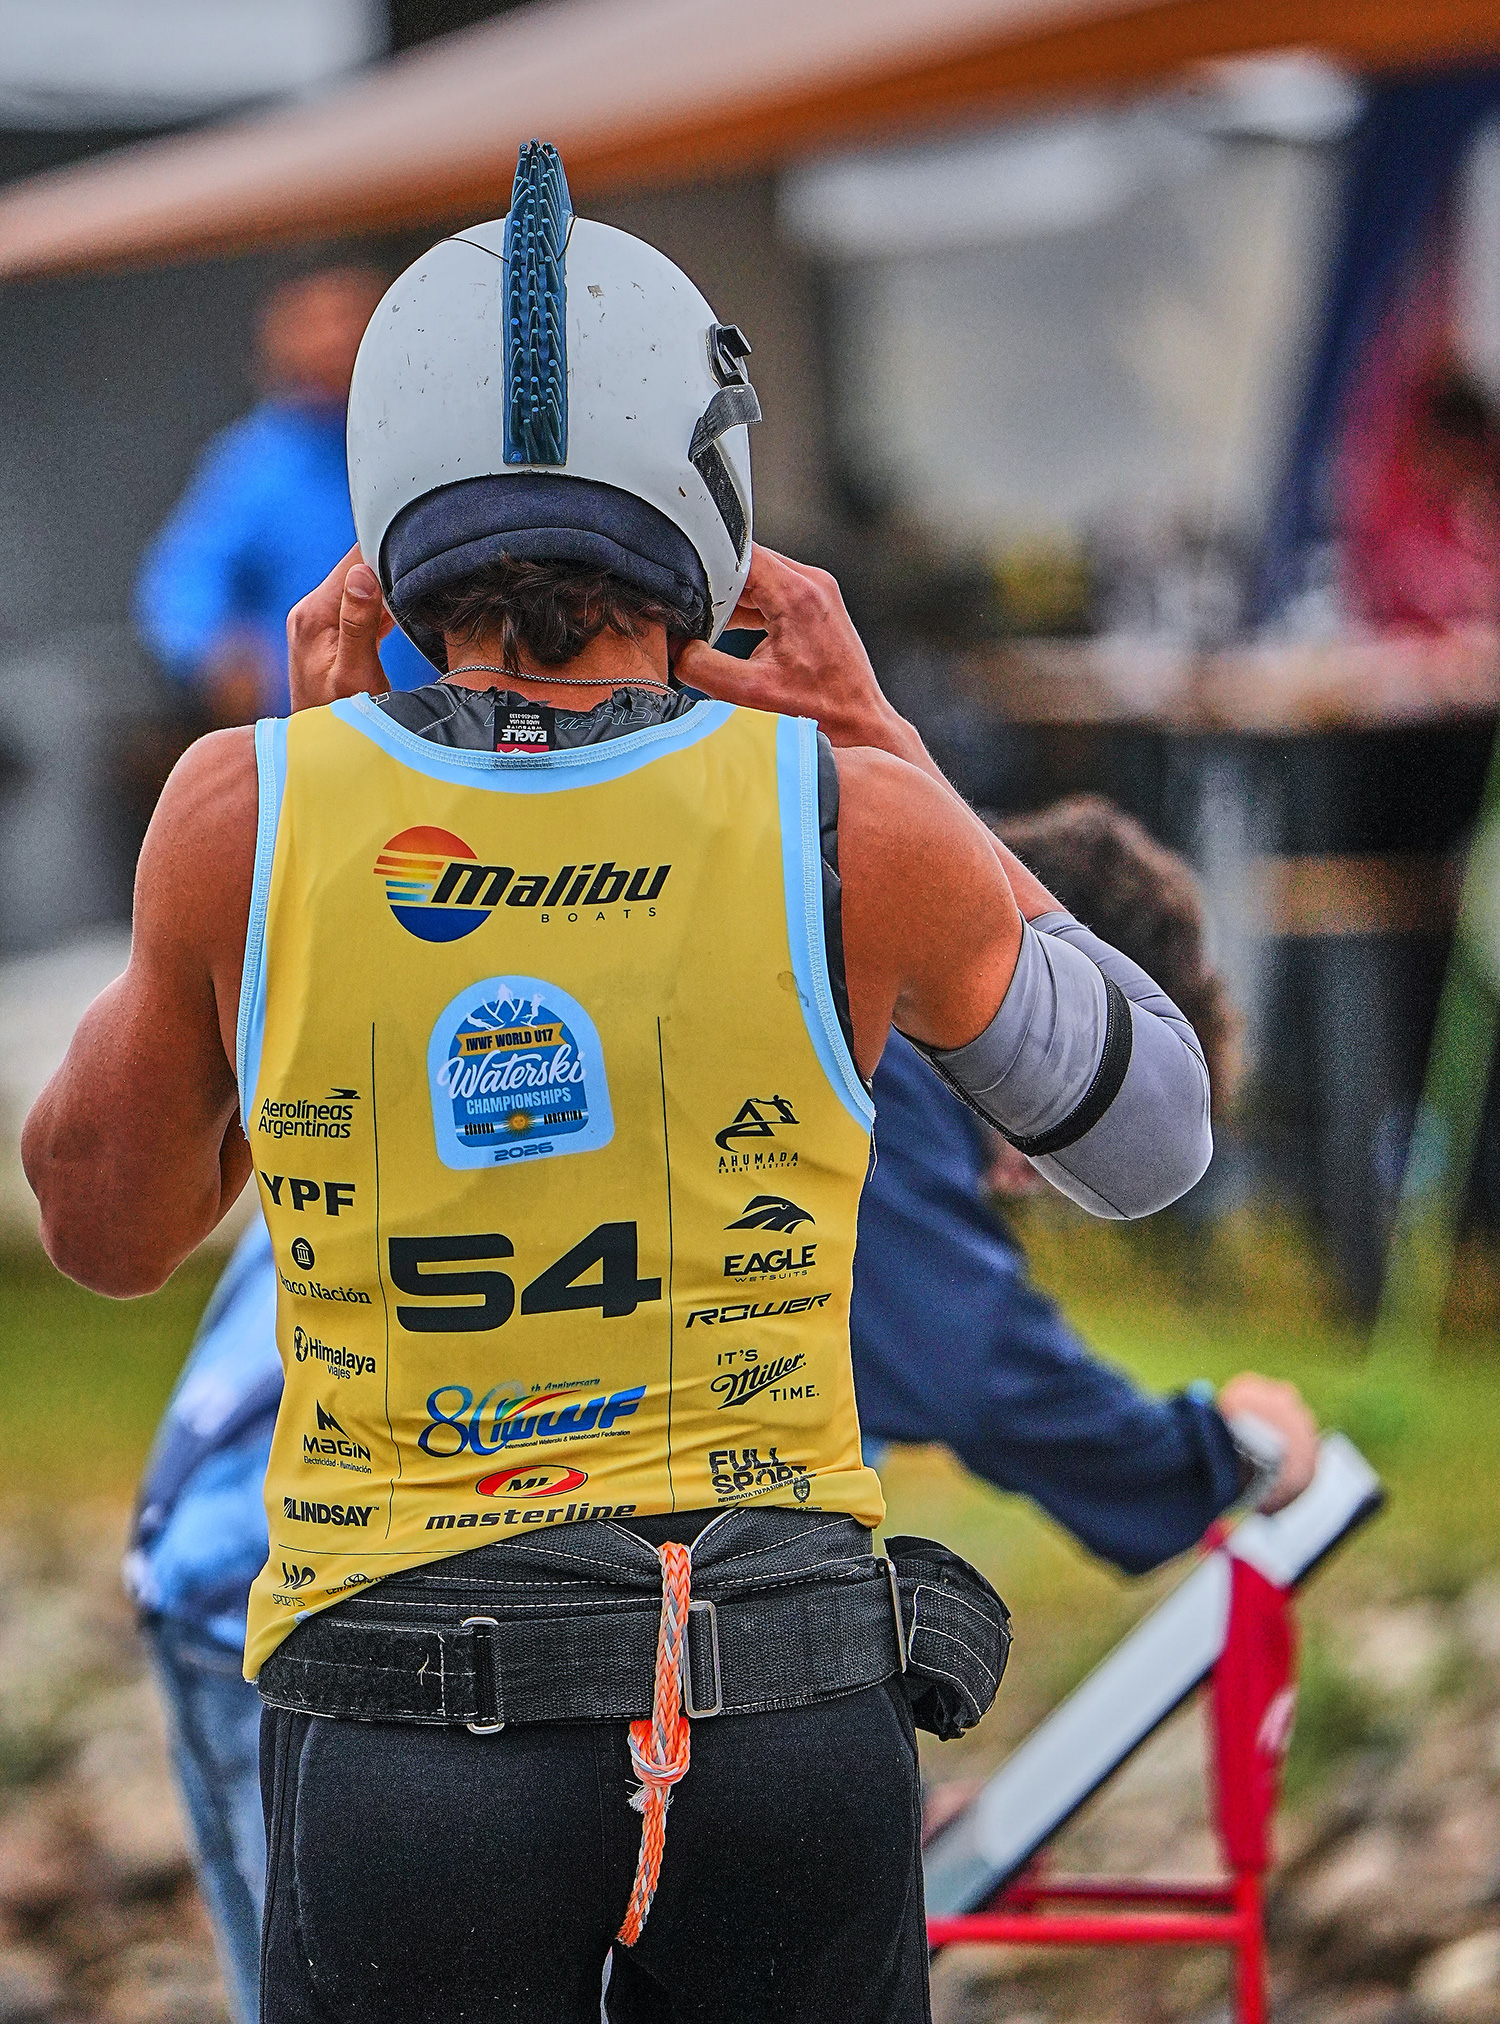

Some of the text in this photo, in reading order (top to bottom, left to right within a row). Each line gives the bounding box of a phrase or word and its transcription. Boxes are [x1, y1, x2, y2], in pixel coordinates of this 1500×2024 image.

[501, 729, 547, 742] EAGLE
[431, 862, 672, 907] Malibu
[541, 907, 656, 923] BOATS
[466, 1028, 554, 1052] IWWF WORLD U17
[437, 1043, 586, 1099] Waterski
[260, 1098, 353, 1120] Aerolíneas
[466, 1087, 572, 1115] CHAMPIONSHIPS
[258, 1115, 352, 1139] Argentinas
[494, 1141, 554, 1162] 2026
[718, 1152, 799, 1168] AHUMADA
[259, 1170, 356, 1217] YPF
[724, 1243, 818, 1277] EAGLE
[388, 1220, 662, 1333] 54
[734, 1269, 808, 1283] WETSUITS
[308, 1280, 373, 1305] Nación
[308, 1336, 376, 1376] Himalaya
[717, 1349, 758, 1366] IT'S
[544, 1378, 600, 1391] Anniversary
[769, 1384, 820, 1402] TIME.
[708, 1447, 787, 1475] FULL
[424, 1502, 637, 1531] masterline
[272, 1593, 306, 1608] SPORTS
